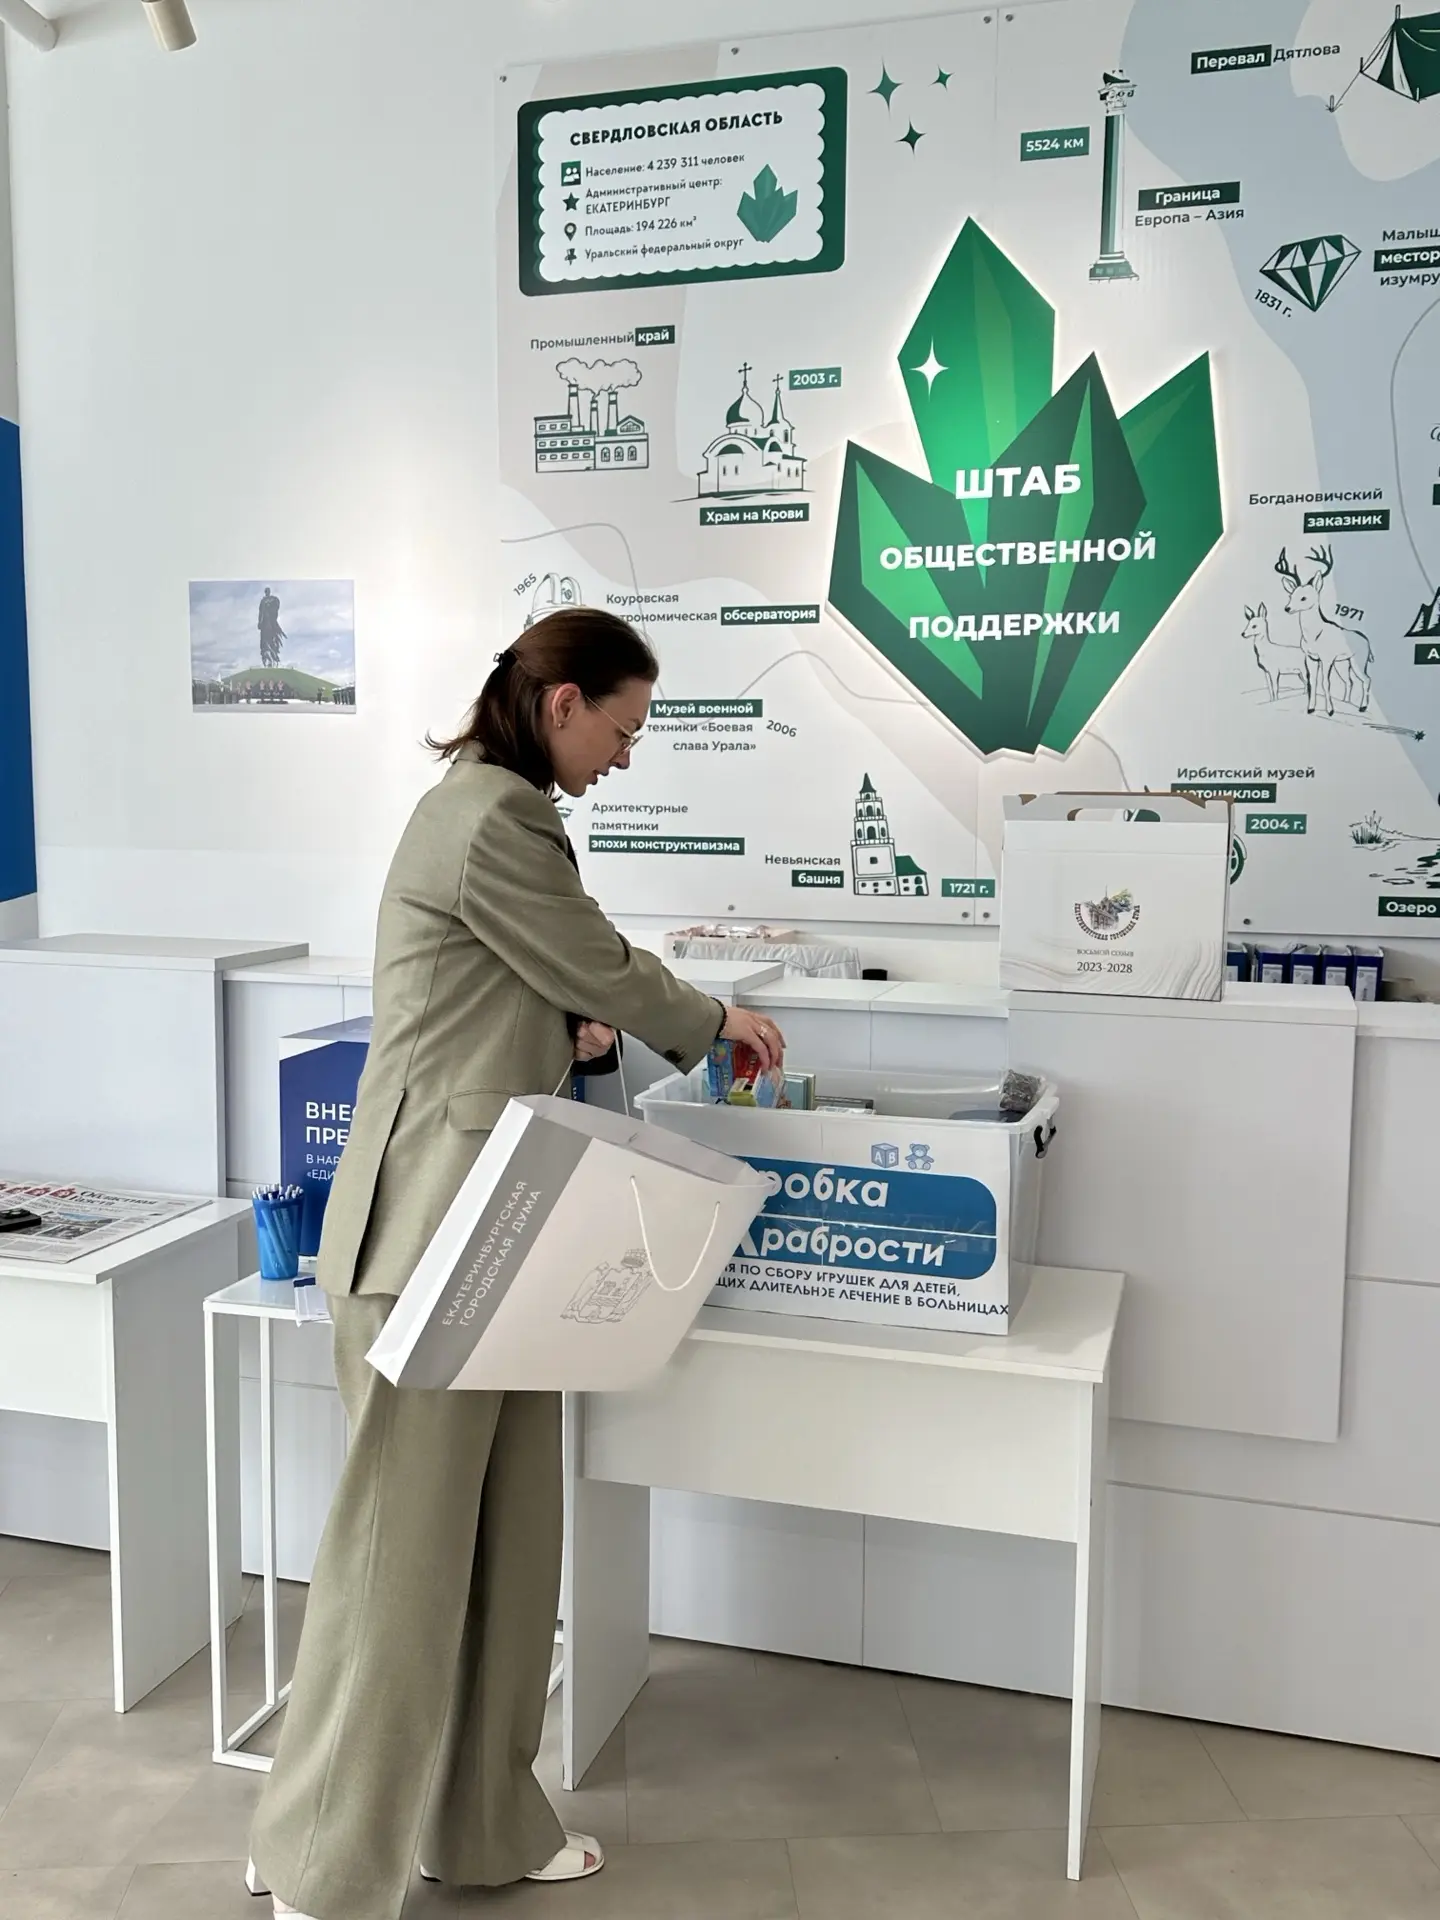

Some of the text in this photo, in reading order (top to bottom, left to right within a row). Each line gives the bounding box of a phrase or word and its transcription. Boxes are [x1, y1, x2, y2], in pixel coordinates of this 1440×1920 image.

[1196, 43, 1341, 70] Перевал Дятлова
[570, 111, 783, 146] СВЕРДЛОВСКАЯ ОБЛАСТЬ
[1026, 137, 1084, 152] 5524 км
[585, 152, 746, 176] Население: 4 239 311 человек
[585, 177, 723, 200] Административный центр:
[1155, 186, 1220, 205] Граница
[586, 196, 671, 215] ЕКАТЕРИНБУРГ
[1134, 211, 1191, 228] Европа
[1205, 207, 1244, 221] Азия
[585, 223, 634, 239] Площадь:
[636, 220, 655, 232] 194
[658, 218, 678, 231] 226
[585, 237, 744, 262] Уральский федеральный округ
[1381, 250, 1440, 264] местор
[1380, 273, 1440, 288] изумру
[1254, 289, 1282, 312] 1831
[530, 328, 670, 350] Промышленный край
[793, 372, 838, 386] 2003 г.
[955, 463, 1081, 500] ШТАБ
[1249, 488, 1383, 505] Богдановичский
[706, 507, 804, 525] Храм на Крови
[1307, 514, 1382, 527] заказник
[879, 531, 1156, 572] ОБЩЕСТВЕННОЙ
[513, 573, 537, 596] 1965
[606, 592, 679, 606] Коуровская
[617, 608, 817, 625] трономическая обсерватория
[1334, 603, 1364, 621] 1971
[909, 611, 1120, 642] ПОДДЕРЖКИ
[655, 702, 753, 716] Музей военной
[647, 720, 797, 737] техники «Боевая 2006
[673, 741, 756, 753] слава Урала»
[1177, 767, 1315, 781] Ирбитский музей
[1176, 788, 1270, 800] тоциклов
[592, 802, 688, 817] Архитектурные
[592, 821, 659, 832] памятники
[1251, 819, 1304, 831] 2004 г.
[591, 838, 740, 853] эпохи конструктивизма
[765, 854, 841, 866] Невьянская
[798, 872, 841, 885] башня
[950, 882, 975, 894] 1721
[1386, 901, 1438, 915] Озеро
[1077, 962, 1133, 974] 2023-2028
[306, 1154, 314, 1163] В
[443, 1180, 528, 1326] ЕКАТЕРИНБУРГСКАЯ
[459, 1190, 542, 1326] ГОРОДСКАЯ ДУМА
[740, 1265, 761, 1276] ПО
[765, 1267, 812, 1282] СБОРУ
[817, 1271, 875, 1287] ИГРУШЕК
[879, 1276, 910, 1291] ДЛЯ
[912, 1279, 960, 1298] ДЕТЕЙ,
[838, 1290, 901, 1306] ЛЕЧЕНИЕ
[904, 1295, 913, 1307] В
[917, 1296, 1009, 1316] БОЛЬНИЦАХ
